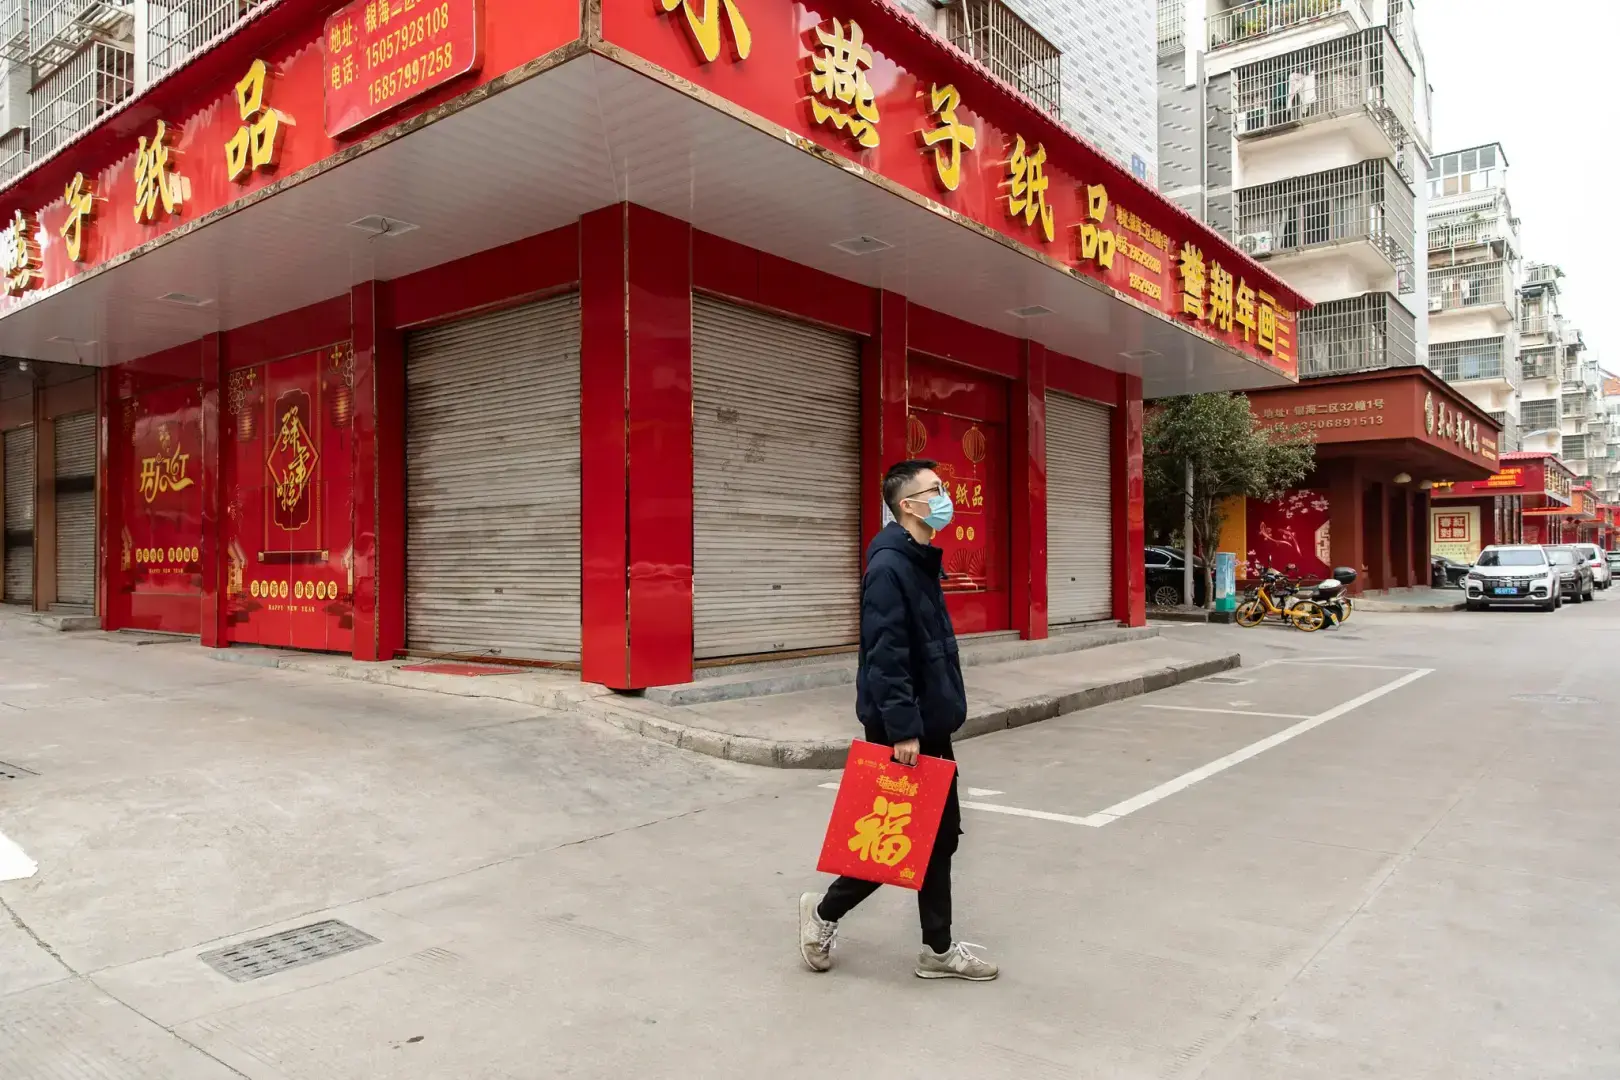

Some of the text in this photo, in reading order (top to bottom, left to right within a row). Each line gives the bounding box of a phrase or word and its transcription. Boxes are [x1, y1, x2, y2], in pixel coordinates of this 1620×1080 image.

[365, 2, 449, 71] 15057928108
[368, 42, 453, 106] 15857997258
[301, 605, 315, 613] YEAR
[847, 795, 913, 868] 福
